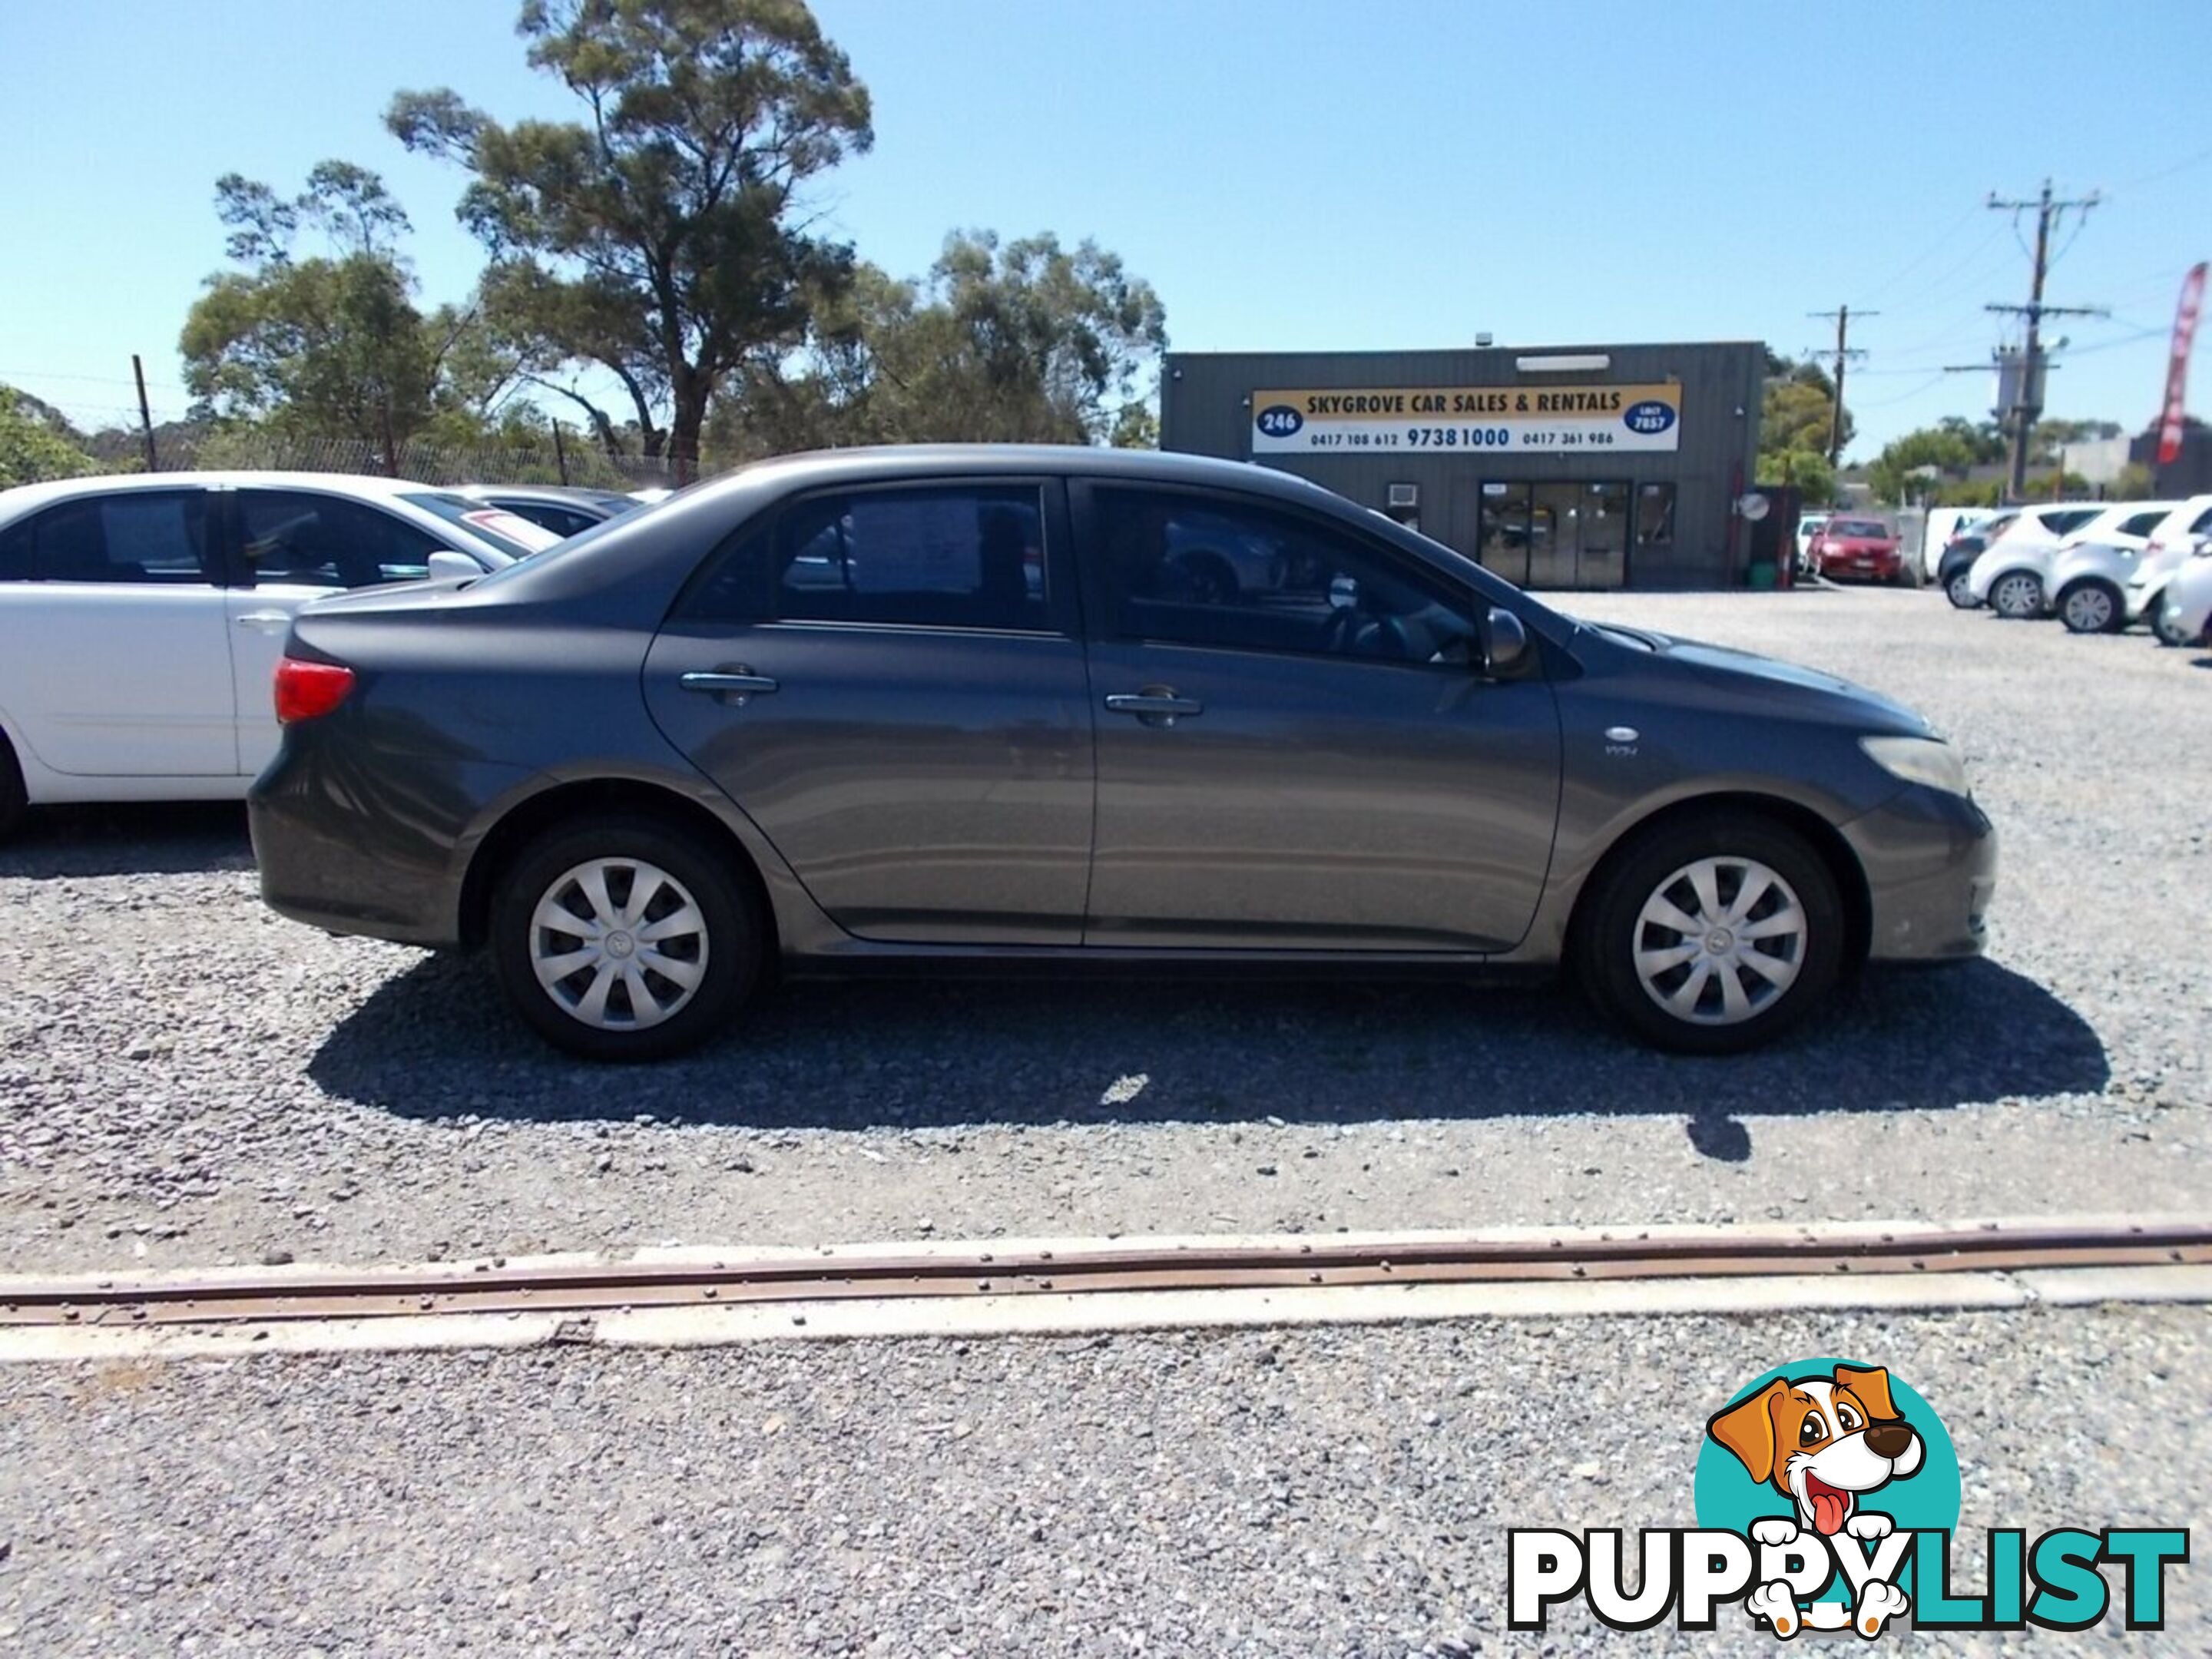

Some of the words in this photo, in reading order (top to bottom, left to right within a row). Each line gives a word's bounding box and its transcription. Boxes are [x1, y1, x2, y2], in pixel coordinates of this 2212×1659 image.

[1307, 395, 1403, 414] SKYGROVE
[1411, 394, 1446, 412] CAR
[1453, 394, 1508, 412] SALES
[1515, 393, 1528, 412] &
[1537, 392, 1621, 412] RENTALS
[1264, 413, 1296, 430] 246
[1311, 434, 1342, 445] 0417
[1374, 434, 1398, 445] 612
[1522, 432, 1555, 445] 0417
[1561, 432, 1583, 445] 361
[1588, 432, 1614, 444] 986
